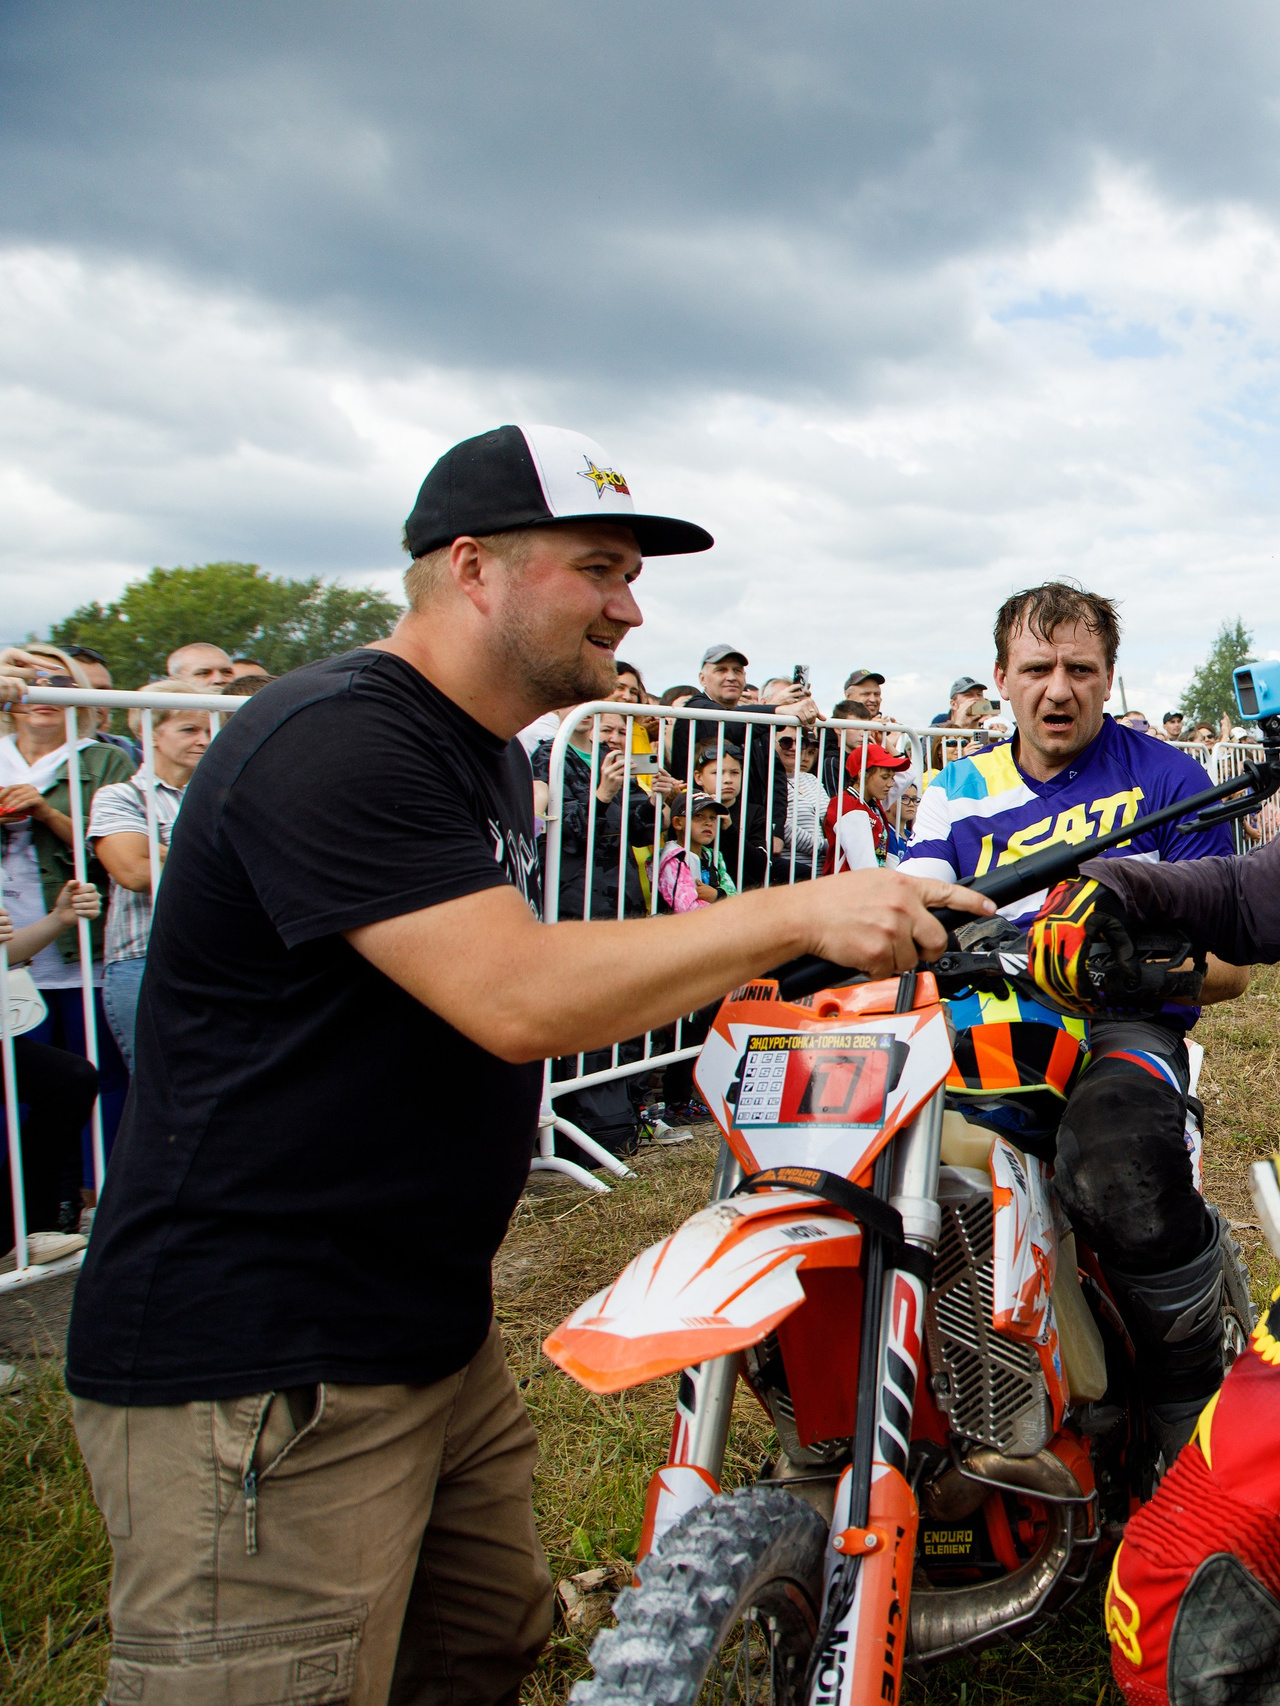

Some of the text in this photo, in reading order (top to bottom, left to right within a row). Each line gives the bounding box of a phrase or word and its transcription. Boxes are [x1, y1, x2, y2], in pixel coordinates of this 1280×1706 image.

[730, 985, 774, 1003] DUNIN
[750, 1035, 877, 1051] ЭНДУРО-ГОНКА-ГОРНАЗ 2024
[749, 1053, 787, 1064] 1 2 3
[745, 1067, 785, 1078] 4 5 6
[743, 1081, 782, 1092] 7 8 9
[797, 1056, 866, 1115] 1
[740, 1097, 753, 1106] 10
[753, 1097, 764, 1106] 11
[751, 1112, 764, 1120] 14
[765, 1112, 778, 1120] 15
[923, 1530, 973, 1544] ENDURO
[925, 1544, 972, 1555] ELEMENT
